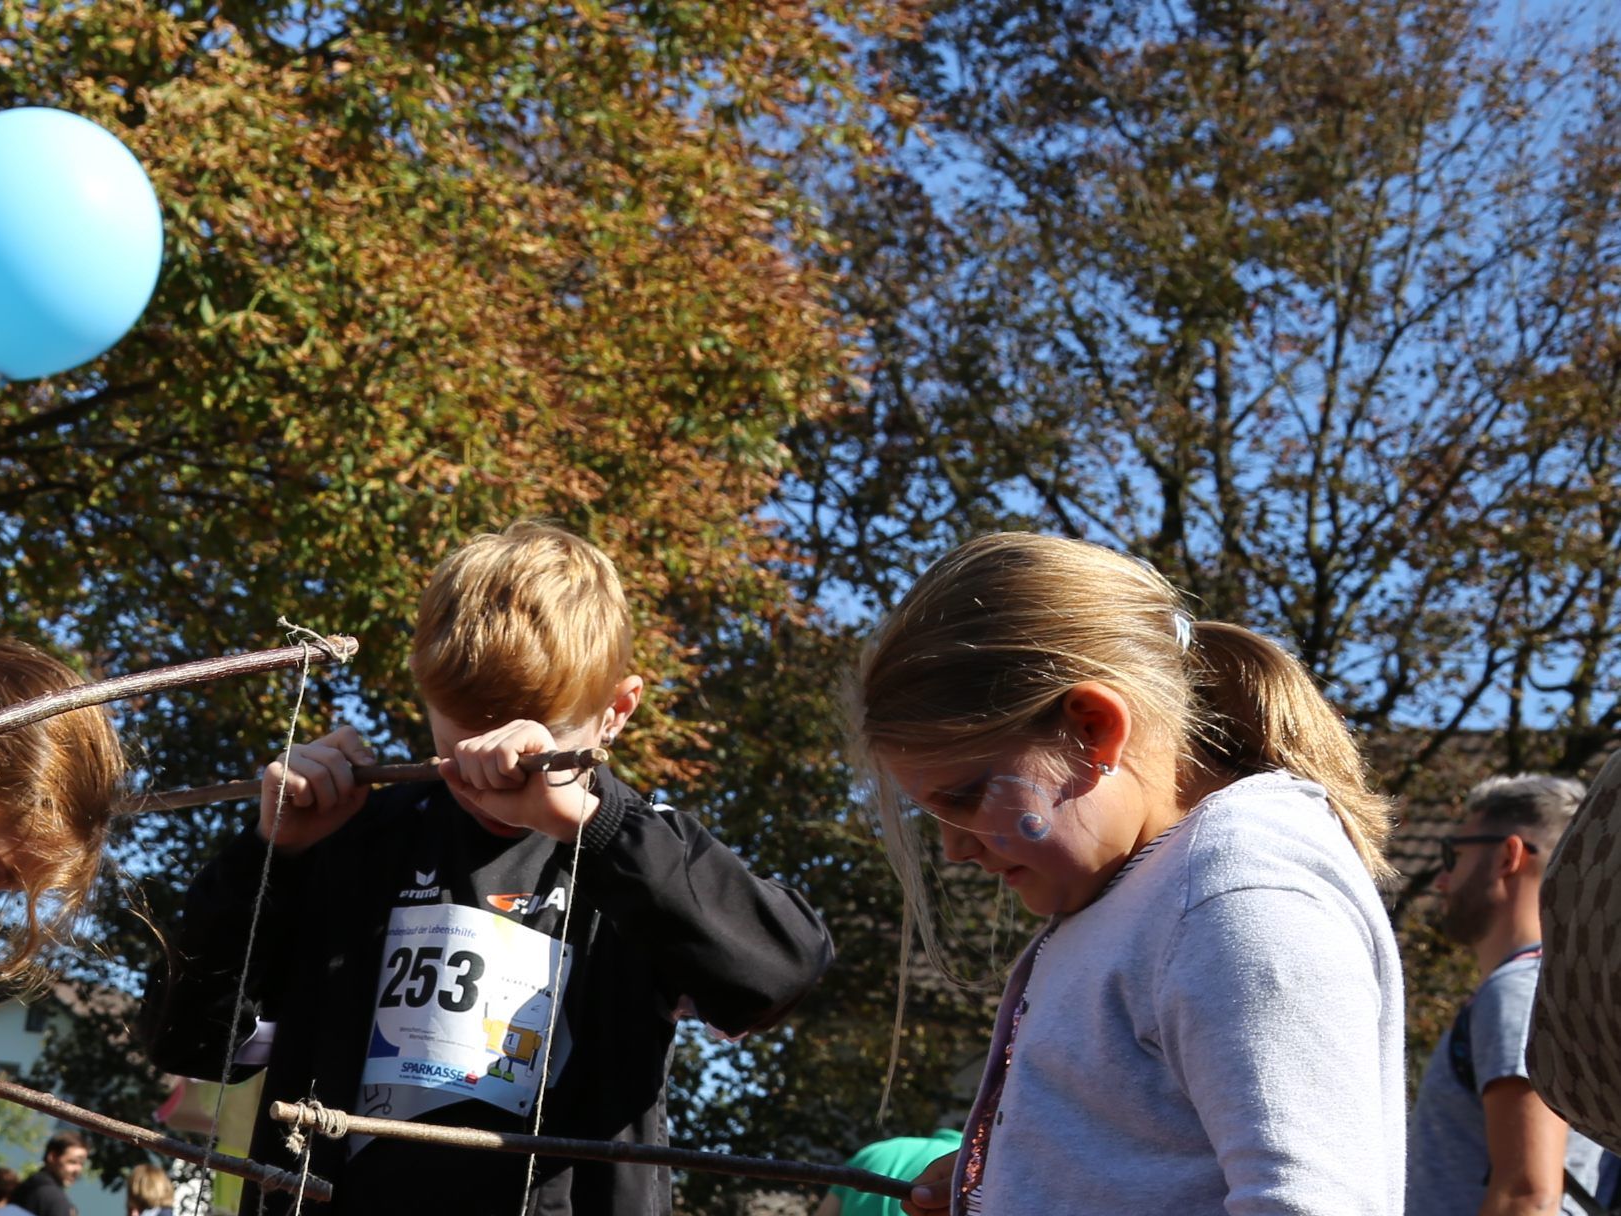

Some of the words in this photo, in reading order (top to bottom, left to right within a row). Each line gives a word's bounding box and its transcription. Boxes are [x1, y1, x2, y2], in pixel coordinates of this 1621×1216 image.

[399, 886, 441, 900] erima
[428, 924, 477, 939] Lebenshilfe
[379, 946, 485, 1013] 253
[401, 1062, 465, 1082] SPARKASSE
